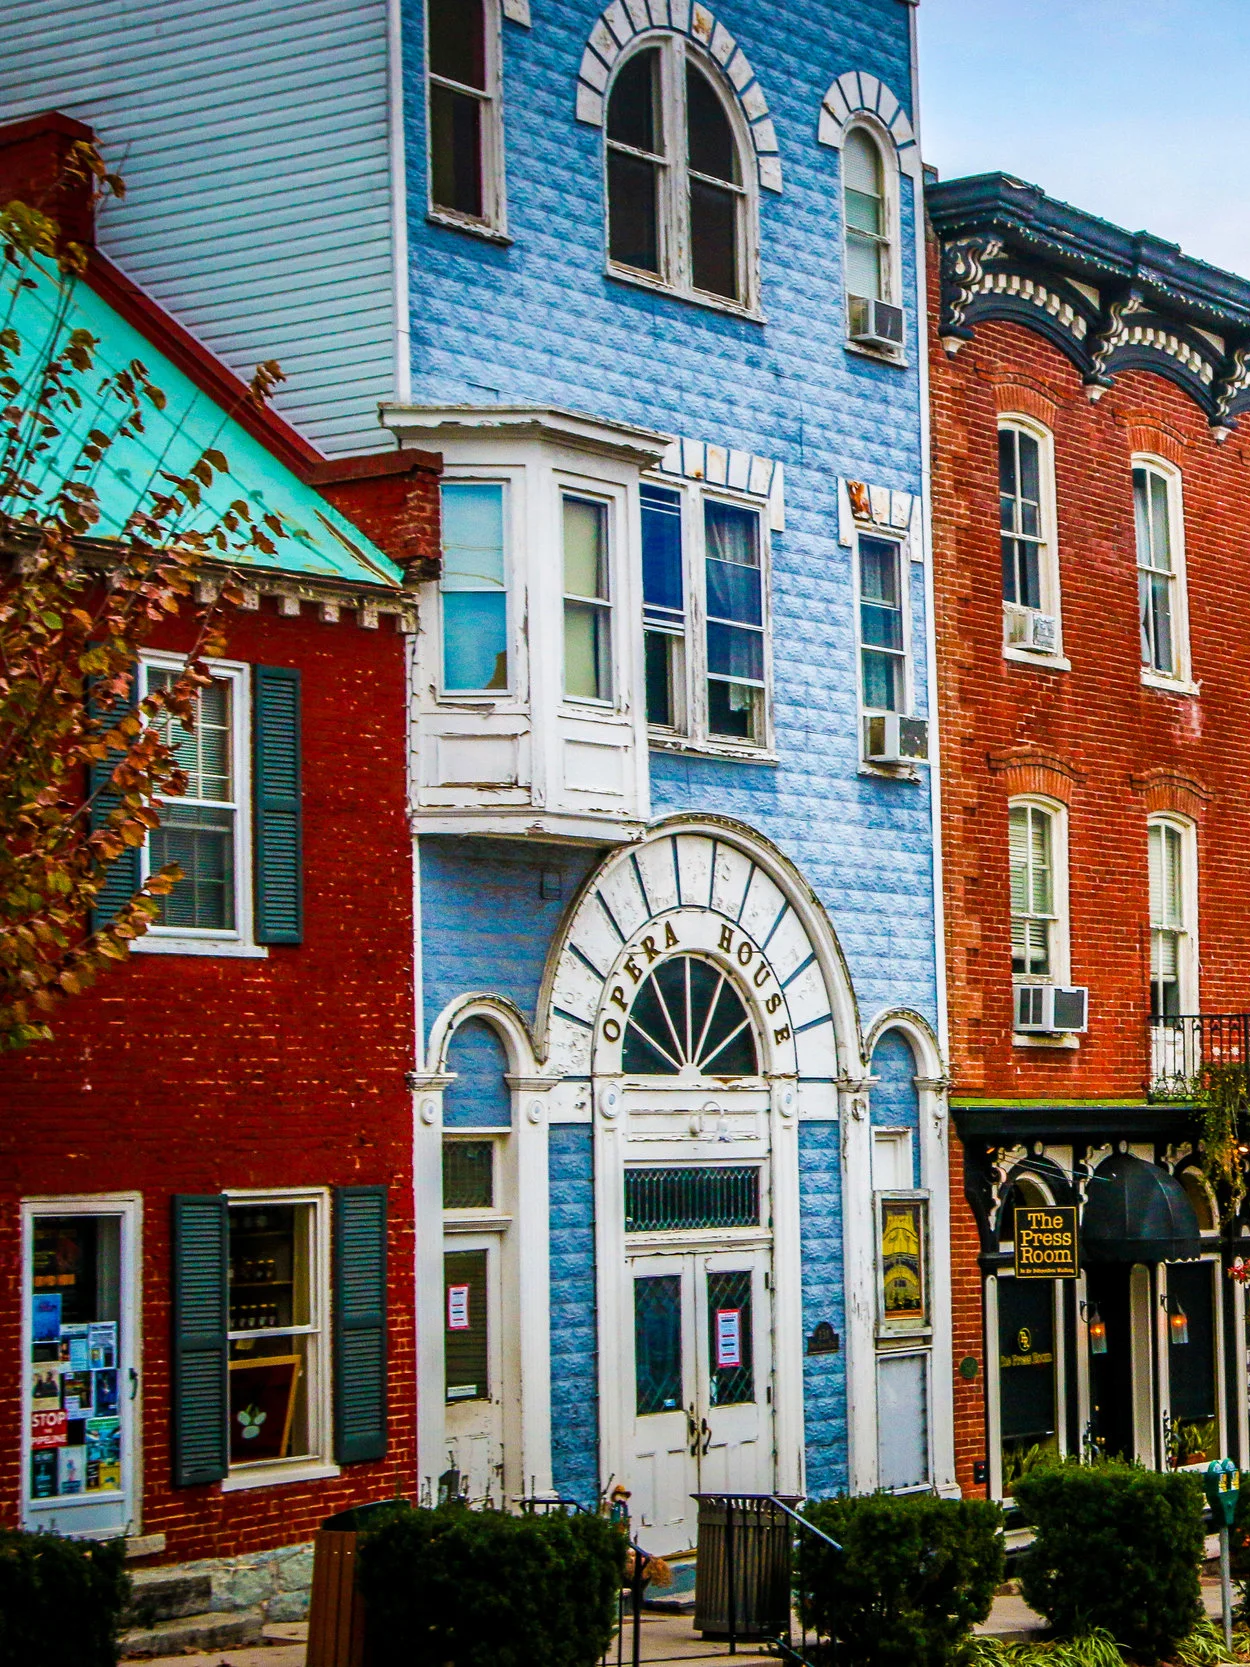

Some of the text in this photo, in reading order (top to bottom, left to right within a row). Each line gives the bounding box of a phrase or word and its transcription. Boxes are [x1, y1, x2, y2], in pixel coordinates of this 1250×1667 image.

[603, 921, 792, 1046] OPERA HOUSE
[1027, 1212, 1064, 1229] The
[1020, 1230, 1072, 1246] Press
[1020, 1247, 1073, 1263] Room
[32, 1412, 66, 1428] STOP
